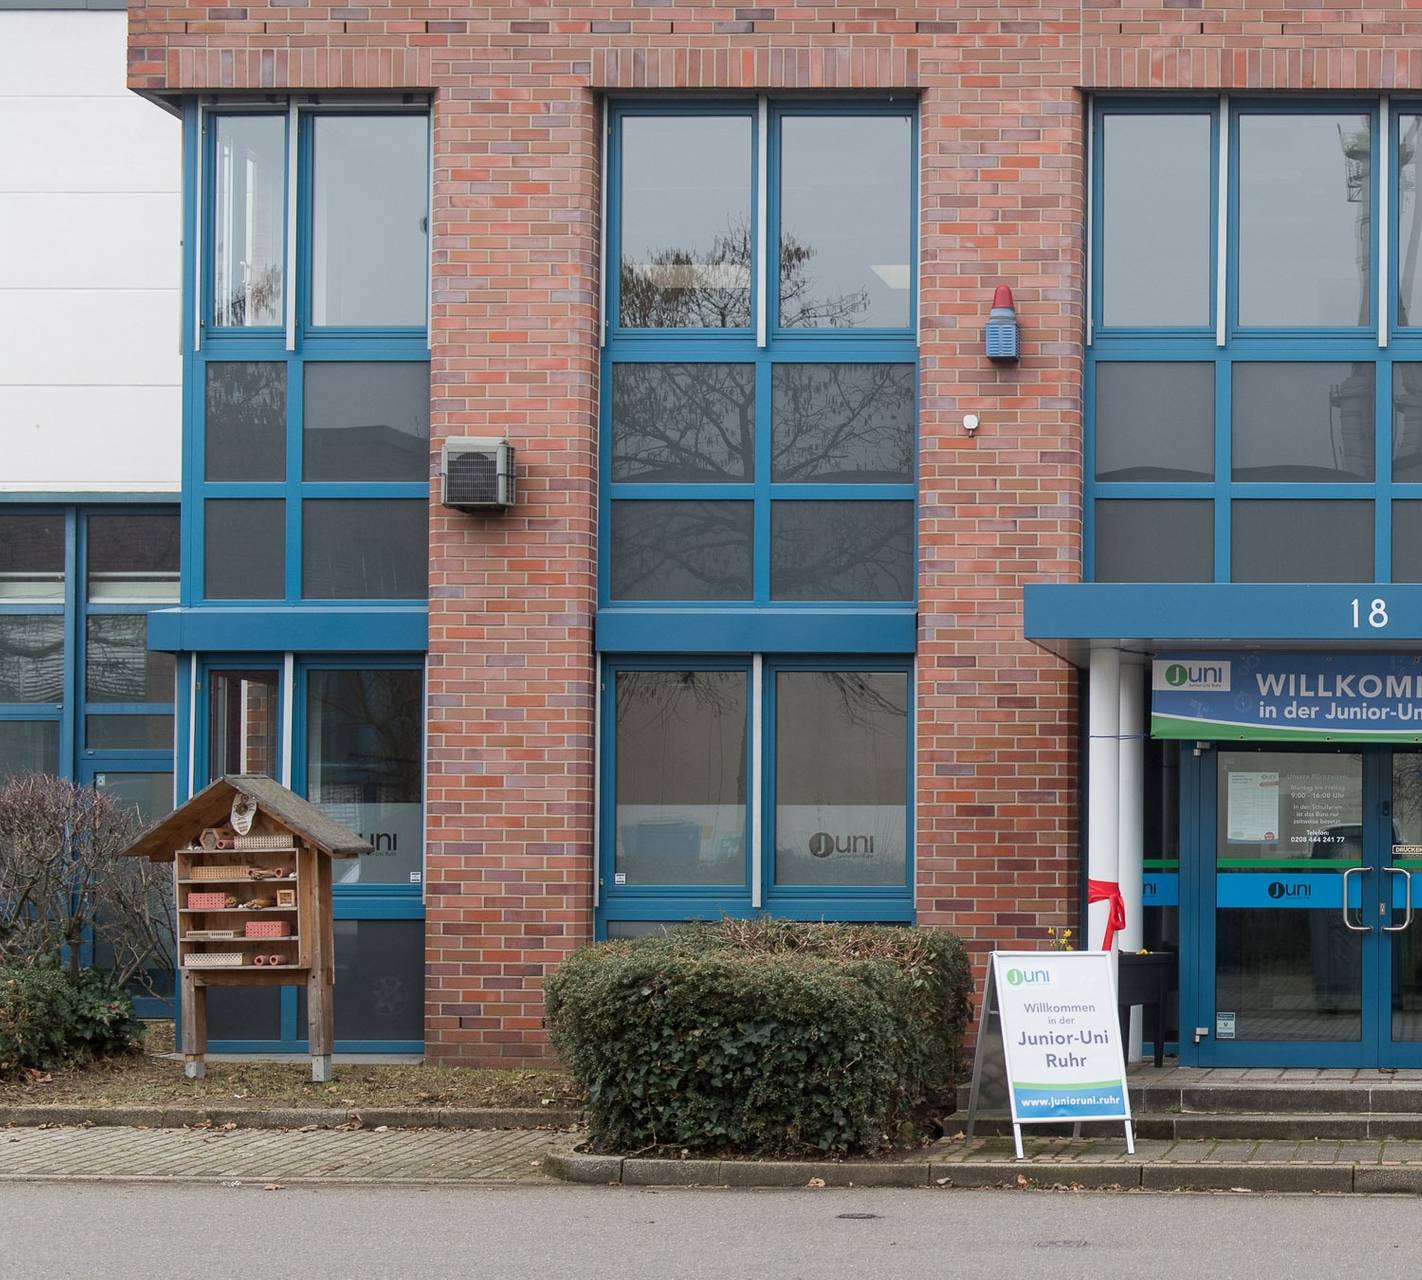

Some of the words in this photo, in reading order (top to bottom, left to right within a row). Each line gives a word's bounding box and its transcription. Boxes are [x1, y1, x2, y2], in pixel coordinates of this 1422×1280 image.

[1351, 598, 1389, 628] 18
[1259, 701, 1277, 718] in
[1284, 701, 1319, 718] der
[1024, 1003, 1096, 1013] Willkommen
[1048, 1017, 1057, 1025] in
[1059, 1016, 1075, 1025] der
[1018, 1030, 1109, 1046] Junior-Uni
[1046, 1052, 1087, 1068] Ruhr
[1021, 1095, 1120, 1108] www.junioruni.ruhr
